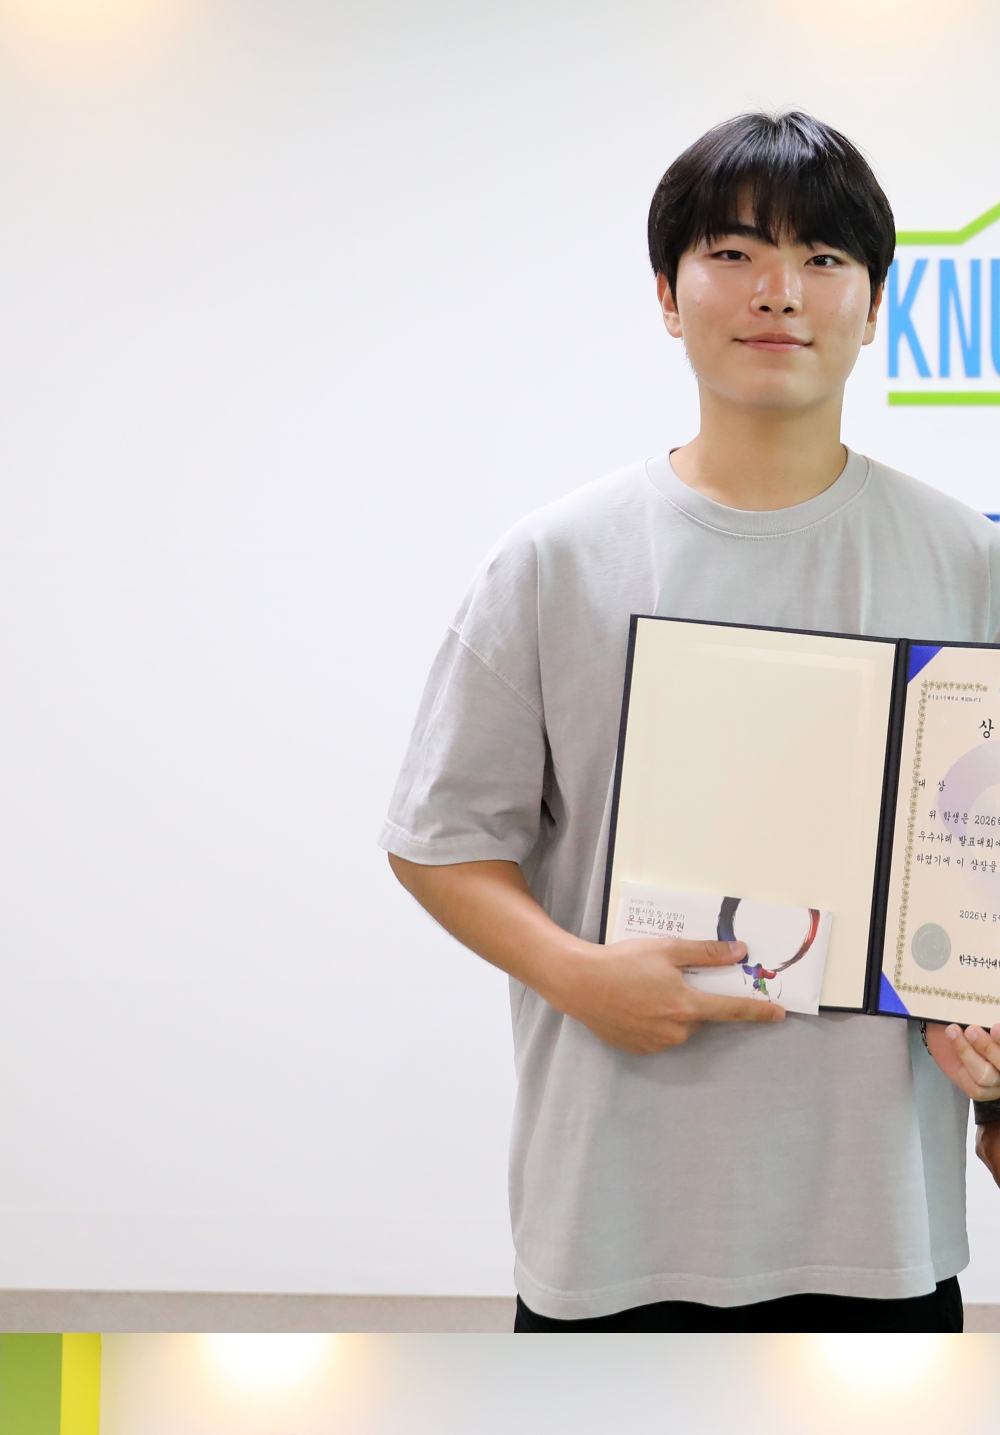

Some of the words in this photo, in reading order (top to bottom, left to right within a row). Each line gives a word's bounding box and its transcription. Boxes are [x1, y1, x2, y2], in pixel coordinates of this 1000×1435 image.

[978, 718, 994, 738] 상
[937, 780, 945, 791] 상
[929, 810, 936, 820] 위
[944, 811, 969, 824] 학생은
[918, 831, 952, 844] 우수사례
[916, 854, 950, 866] 하였기에
[957, 858, 963, 868] 이
[971, 859, 997, 873] 상장을
[960, 910, 986, 922] 2026년
[627, 915, 684, 932] 온누리상품권
